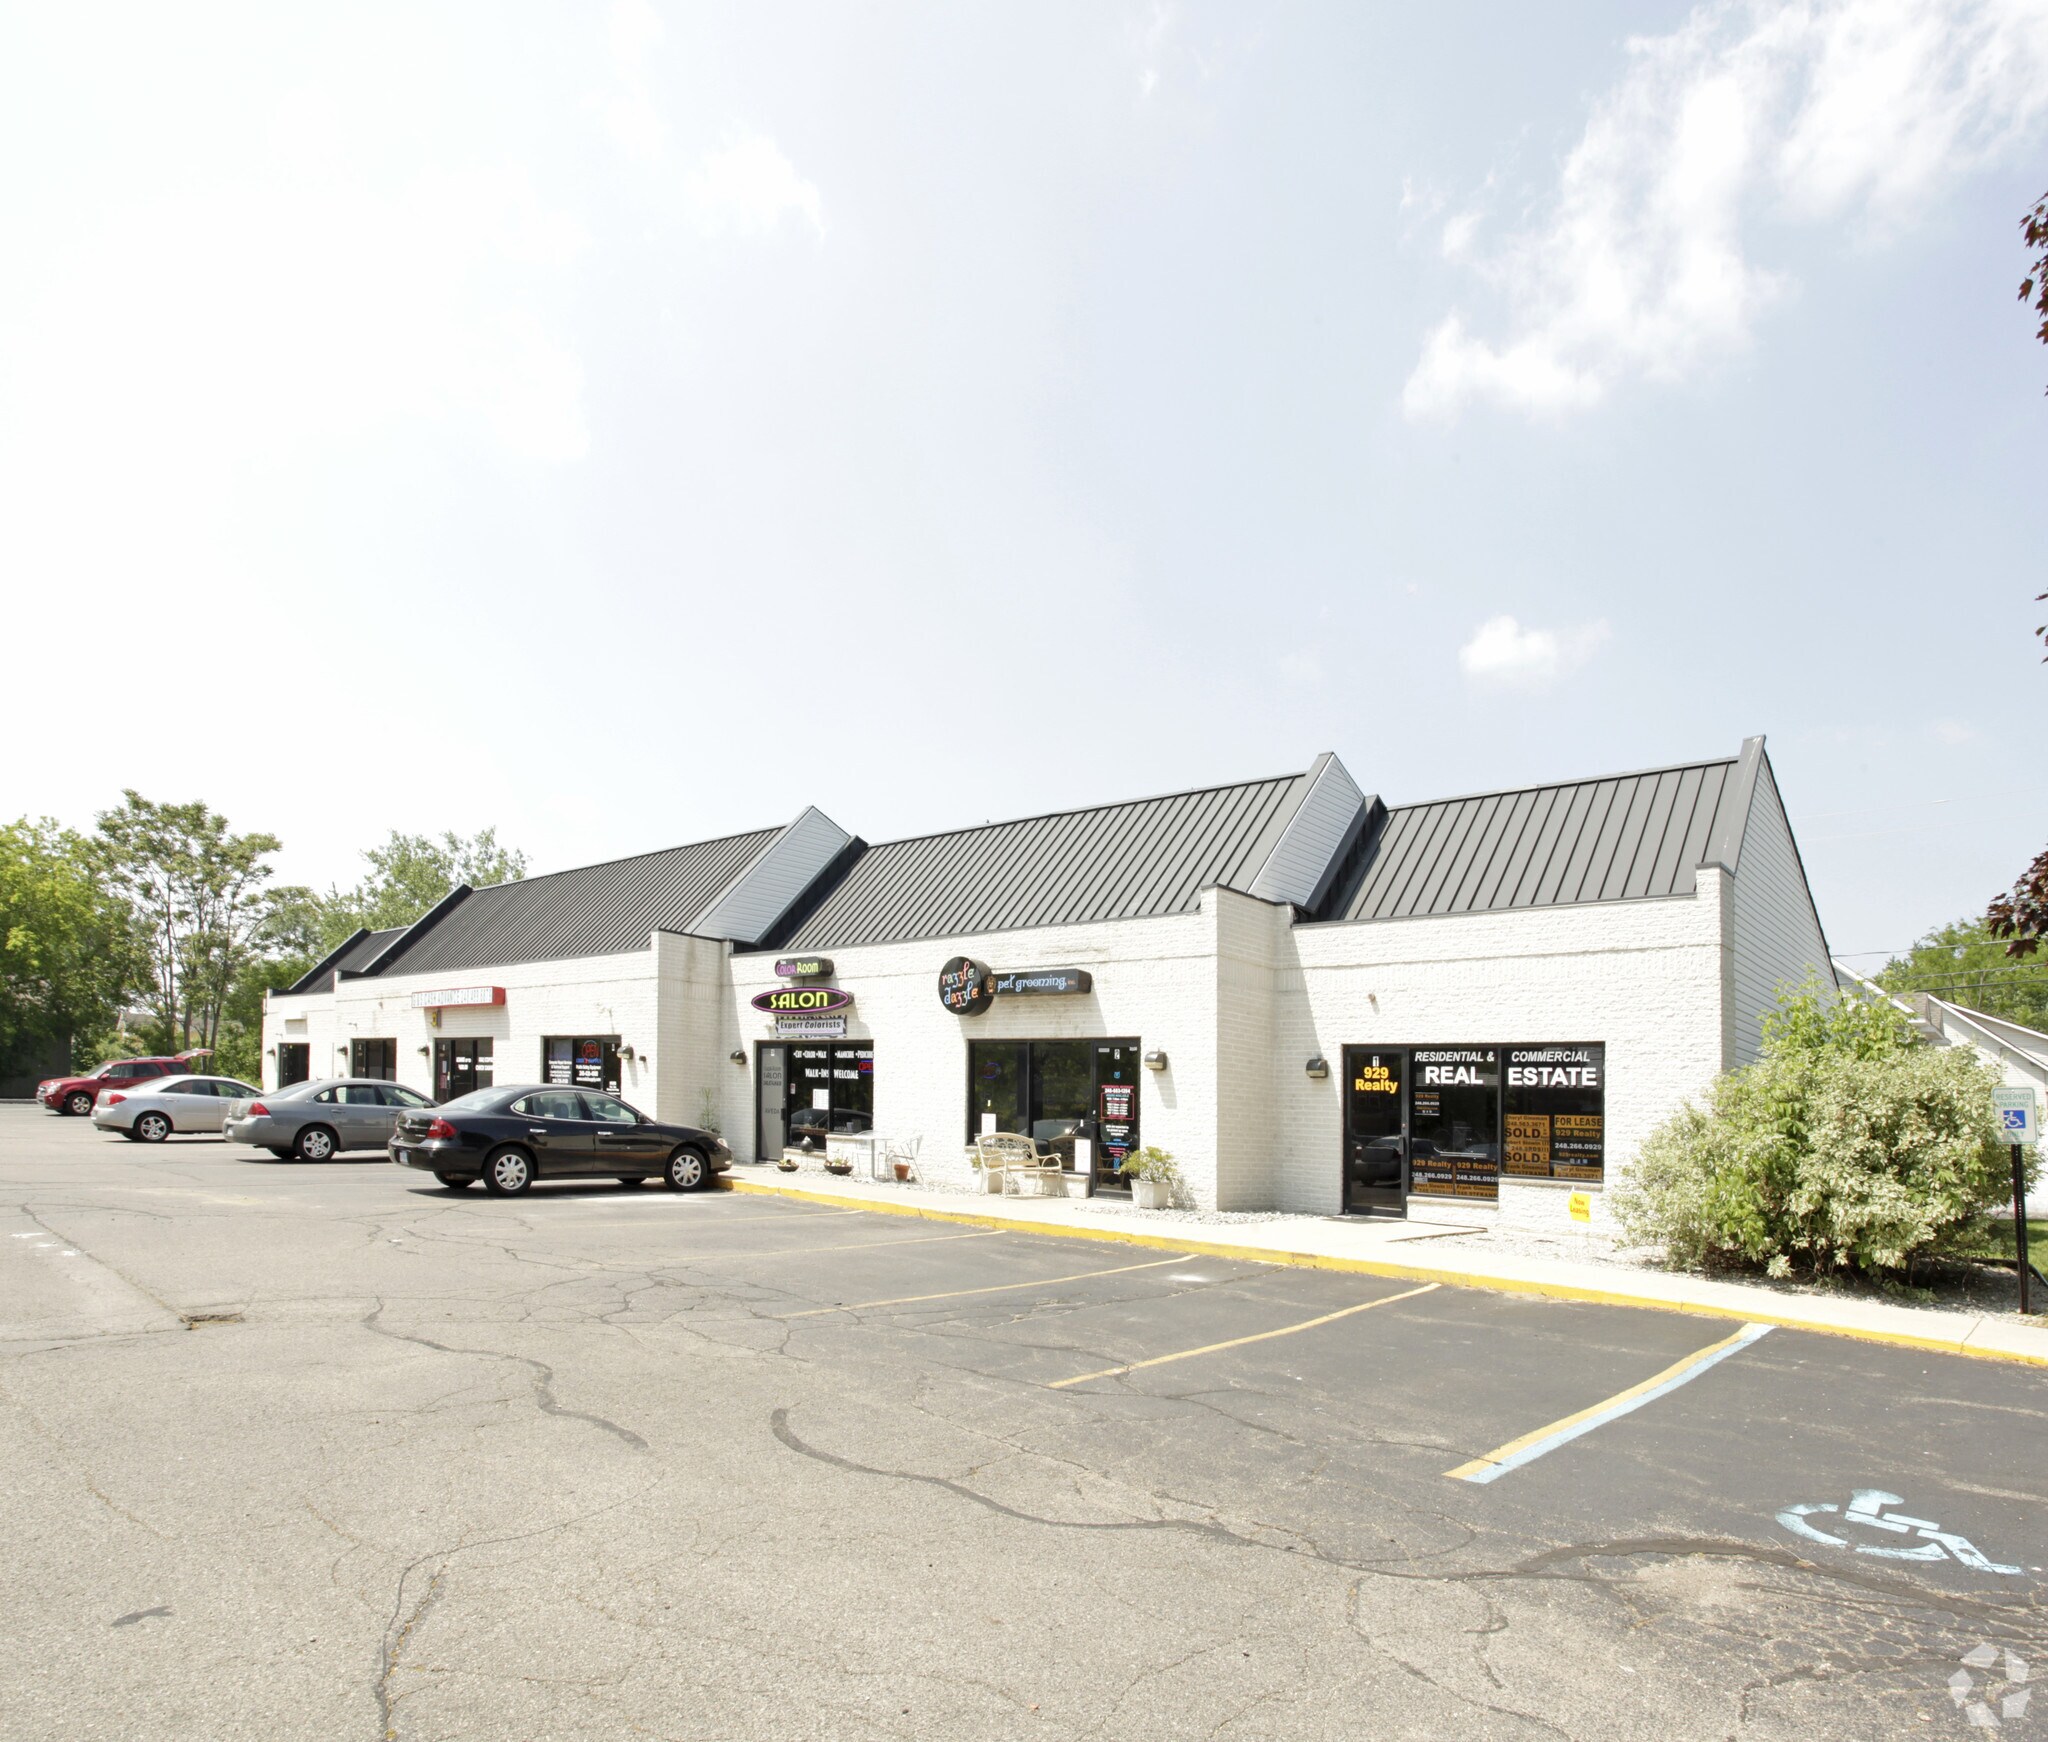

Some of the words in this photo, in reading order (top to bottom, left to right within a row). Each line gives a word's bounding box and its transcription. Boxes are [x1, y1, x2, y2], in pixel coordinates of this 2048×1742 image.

[942, 961, 975, 988] razzle
[998, 975, 1015, 992] pet
[944, 981, 978, 1008] dazzle
[770, 992, 828, 1009] SALON
[780, 1021, 803, 1029] Expert
[804, 1020, 841, 1029] Colorists
[1414, 1052, 1484, 1062] RESIDENTIAL
[1486, 1051, 1495, 1061] &
[1511, 1051, 1590, 1062] COMMERCIAL
[858, 1062, 874, 1070] OPE
[834, 1069, 859, 1079] WELCOME
[1364, 1066, 1389, 1079] 929
[1425, 1066, 1484, 1084] REAL
[1508, 1067, 1597, 1086] ESTATE
[1355, 1078, 1398, 1094] Realty
[1556, 1117, 1572, 1126] FOR
[1574, 1118, 1602, 1127] LEASE
[1504, 1128, 1540, 1138] SOLD
[1573, 1130, 1600, 1138] Realty
[1504, 1152, 1540, 1163] SOLD
[1428, 1160, 1451, 1169] Realty
[1473, 1162, 1498, 1171] Realty
[1574, 1197, 1584, 1206] Now
[1570, 1204, 1589, 1217] Leasing
